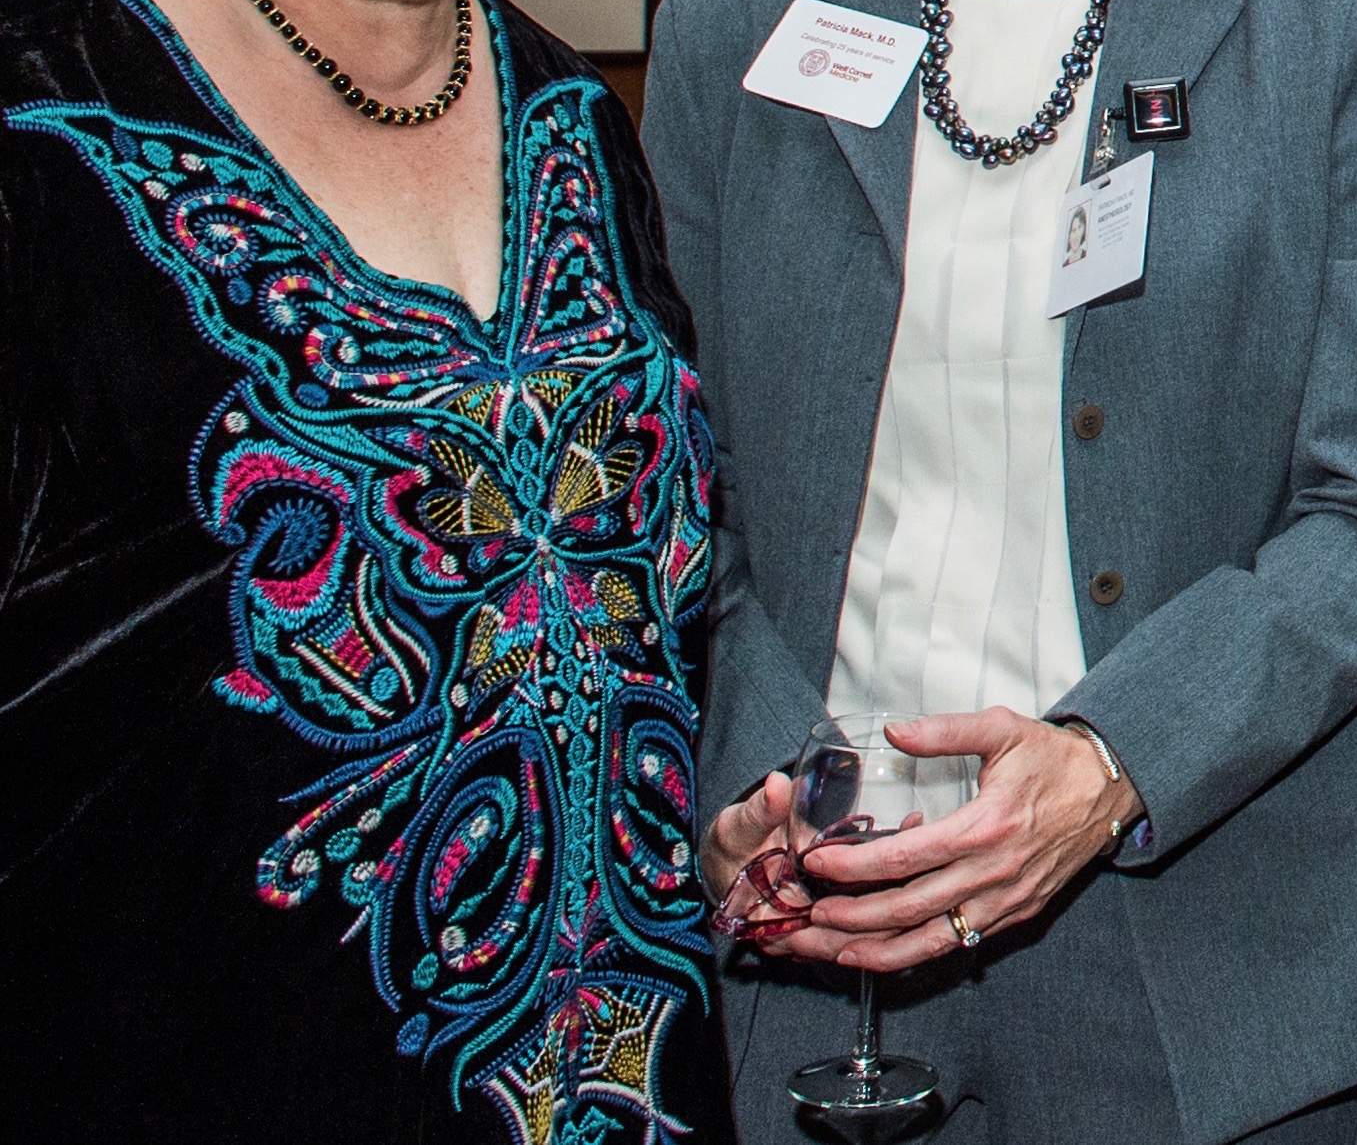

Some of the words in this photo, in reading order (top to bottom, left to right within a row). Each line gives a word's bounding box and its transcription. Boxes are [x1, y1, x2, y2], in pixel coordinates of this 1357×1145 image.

[815, 17, 849, 34] Patricia
[850, 27, 875, 42] Mack,
[877, 34, 896, 47] M.D.
